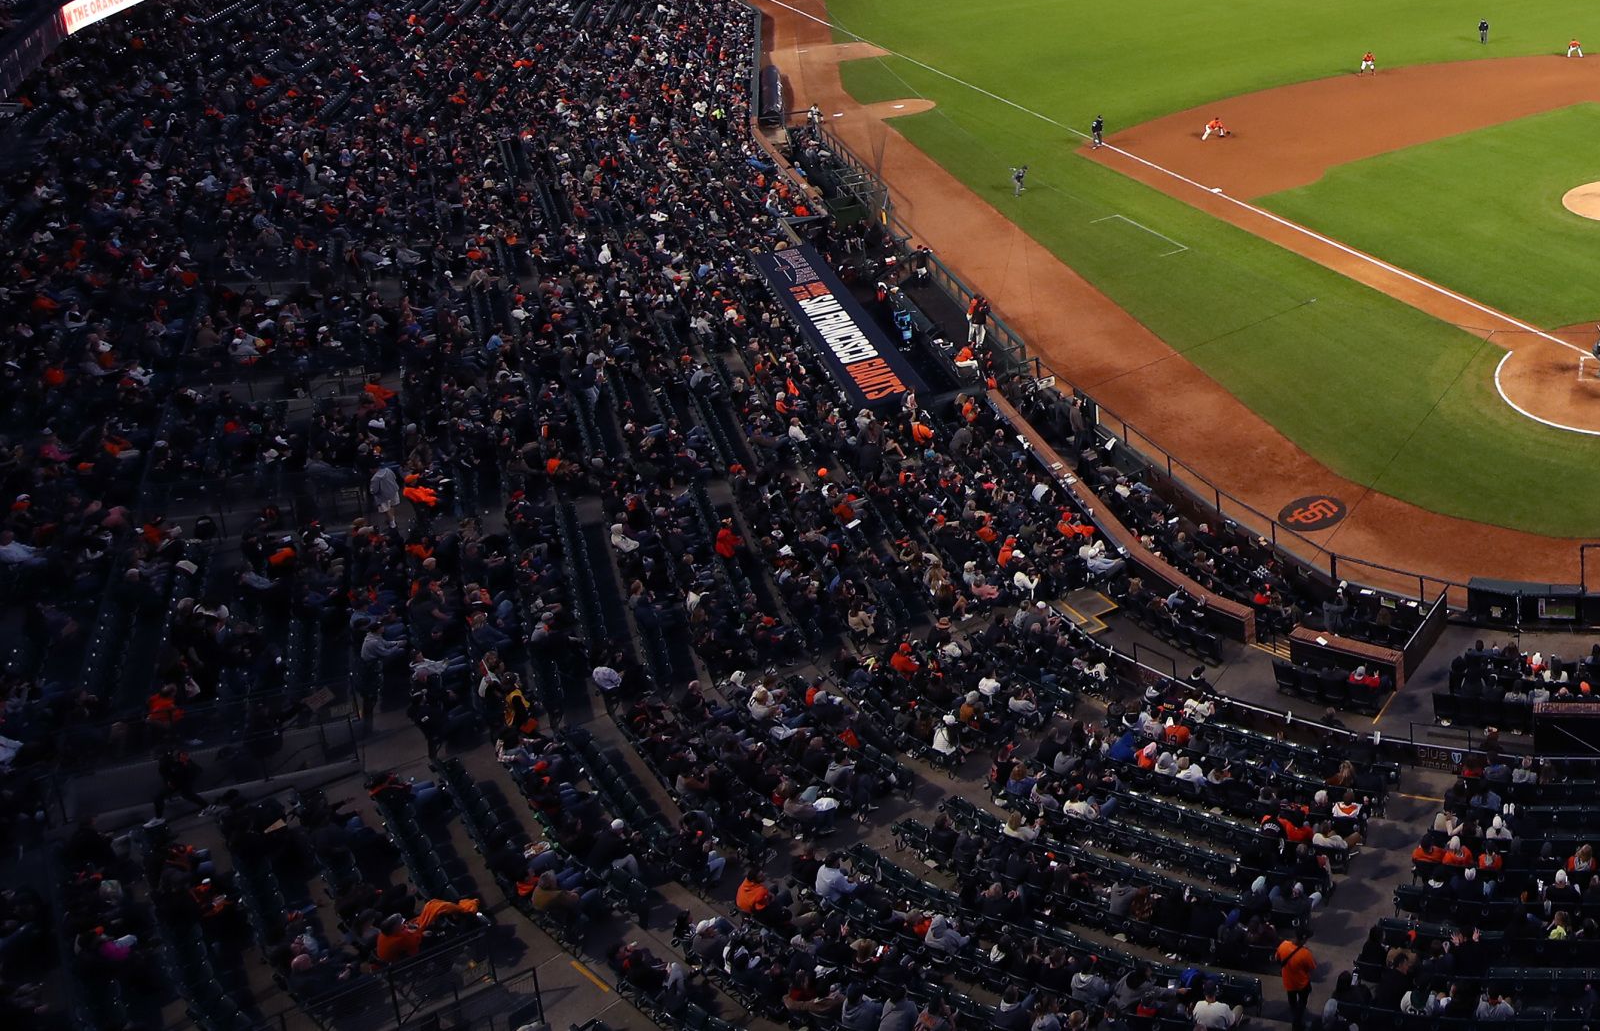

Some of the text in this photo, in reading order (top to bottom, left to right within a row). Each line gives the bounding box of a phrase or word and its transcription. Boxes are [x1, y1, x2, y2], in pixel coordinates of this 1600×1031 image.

[73, 4, 89, 22] THE
[798, 294, 907, 400] SAN FRANCISCO GIANTS
